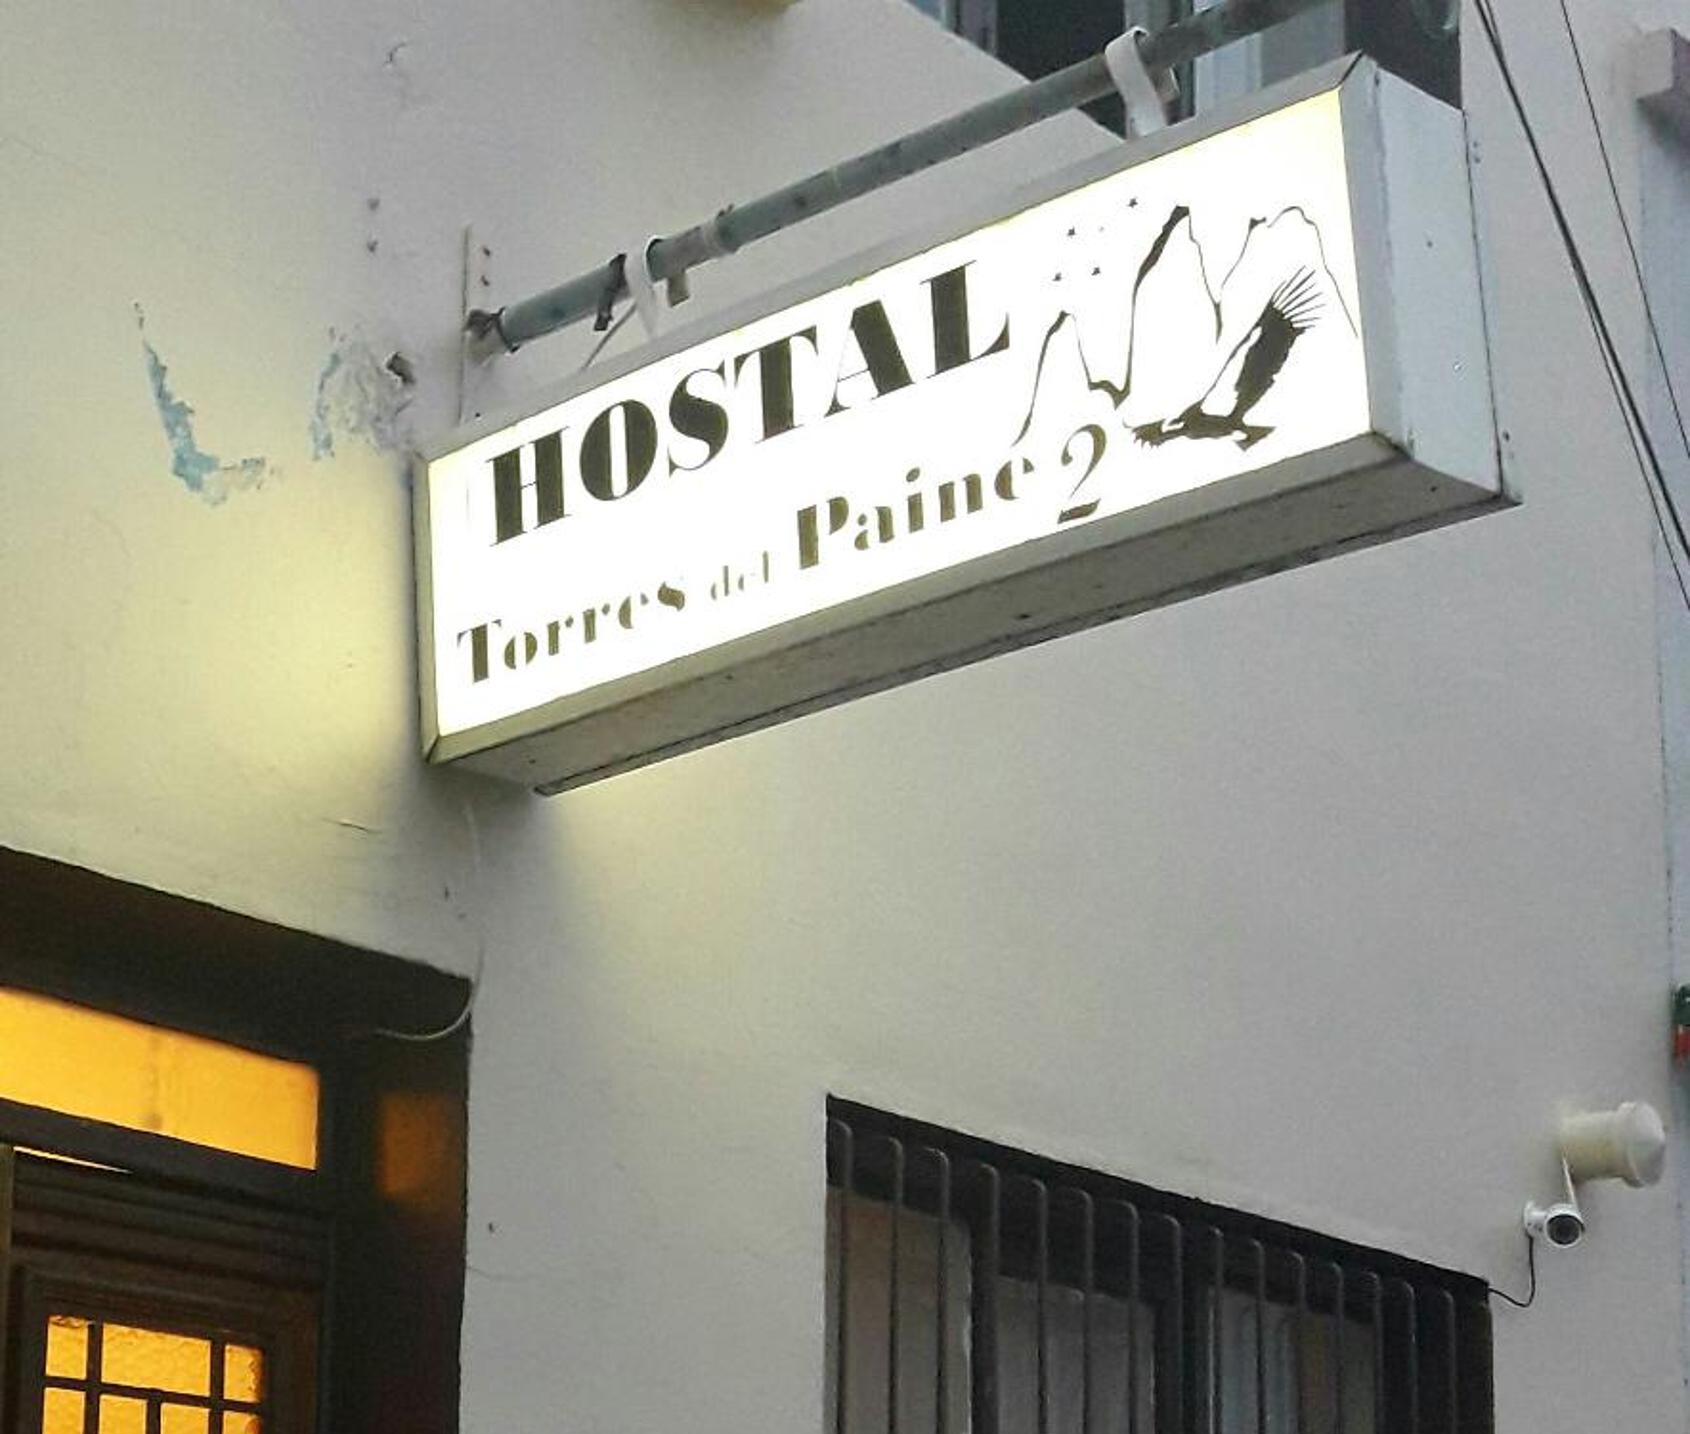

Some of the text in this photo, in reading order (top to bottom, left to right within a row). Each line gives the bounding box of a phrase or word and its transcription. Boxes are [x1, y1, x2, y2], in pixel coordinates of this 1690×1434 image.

[484, 259, 1011, 547] HOSTAL
[456, 423, 1108, 684] Torres del Paine 2
